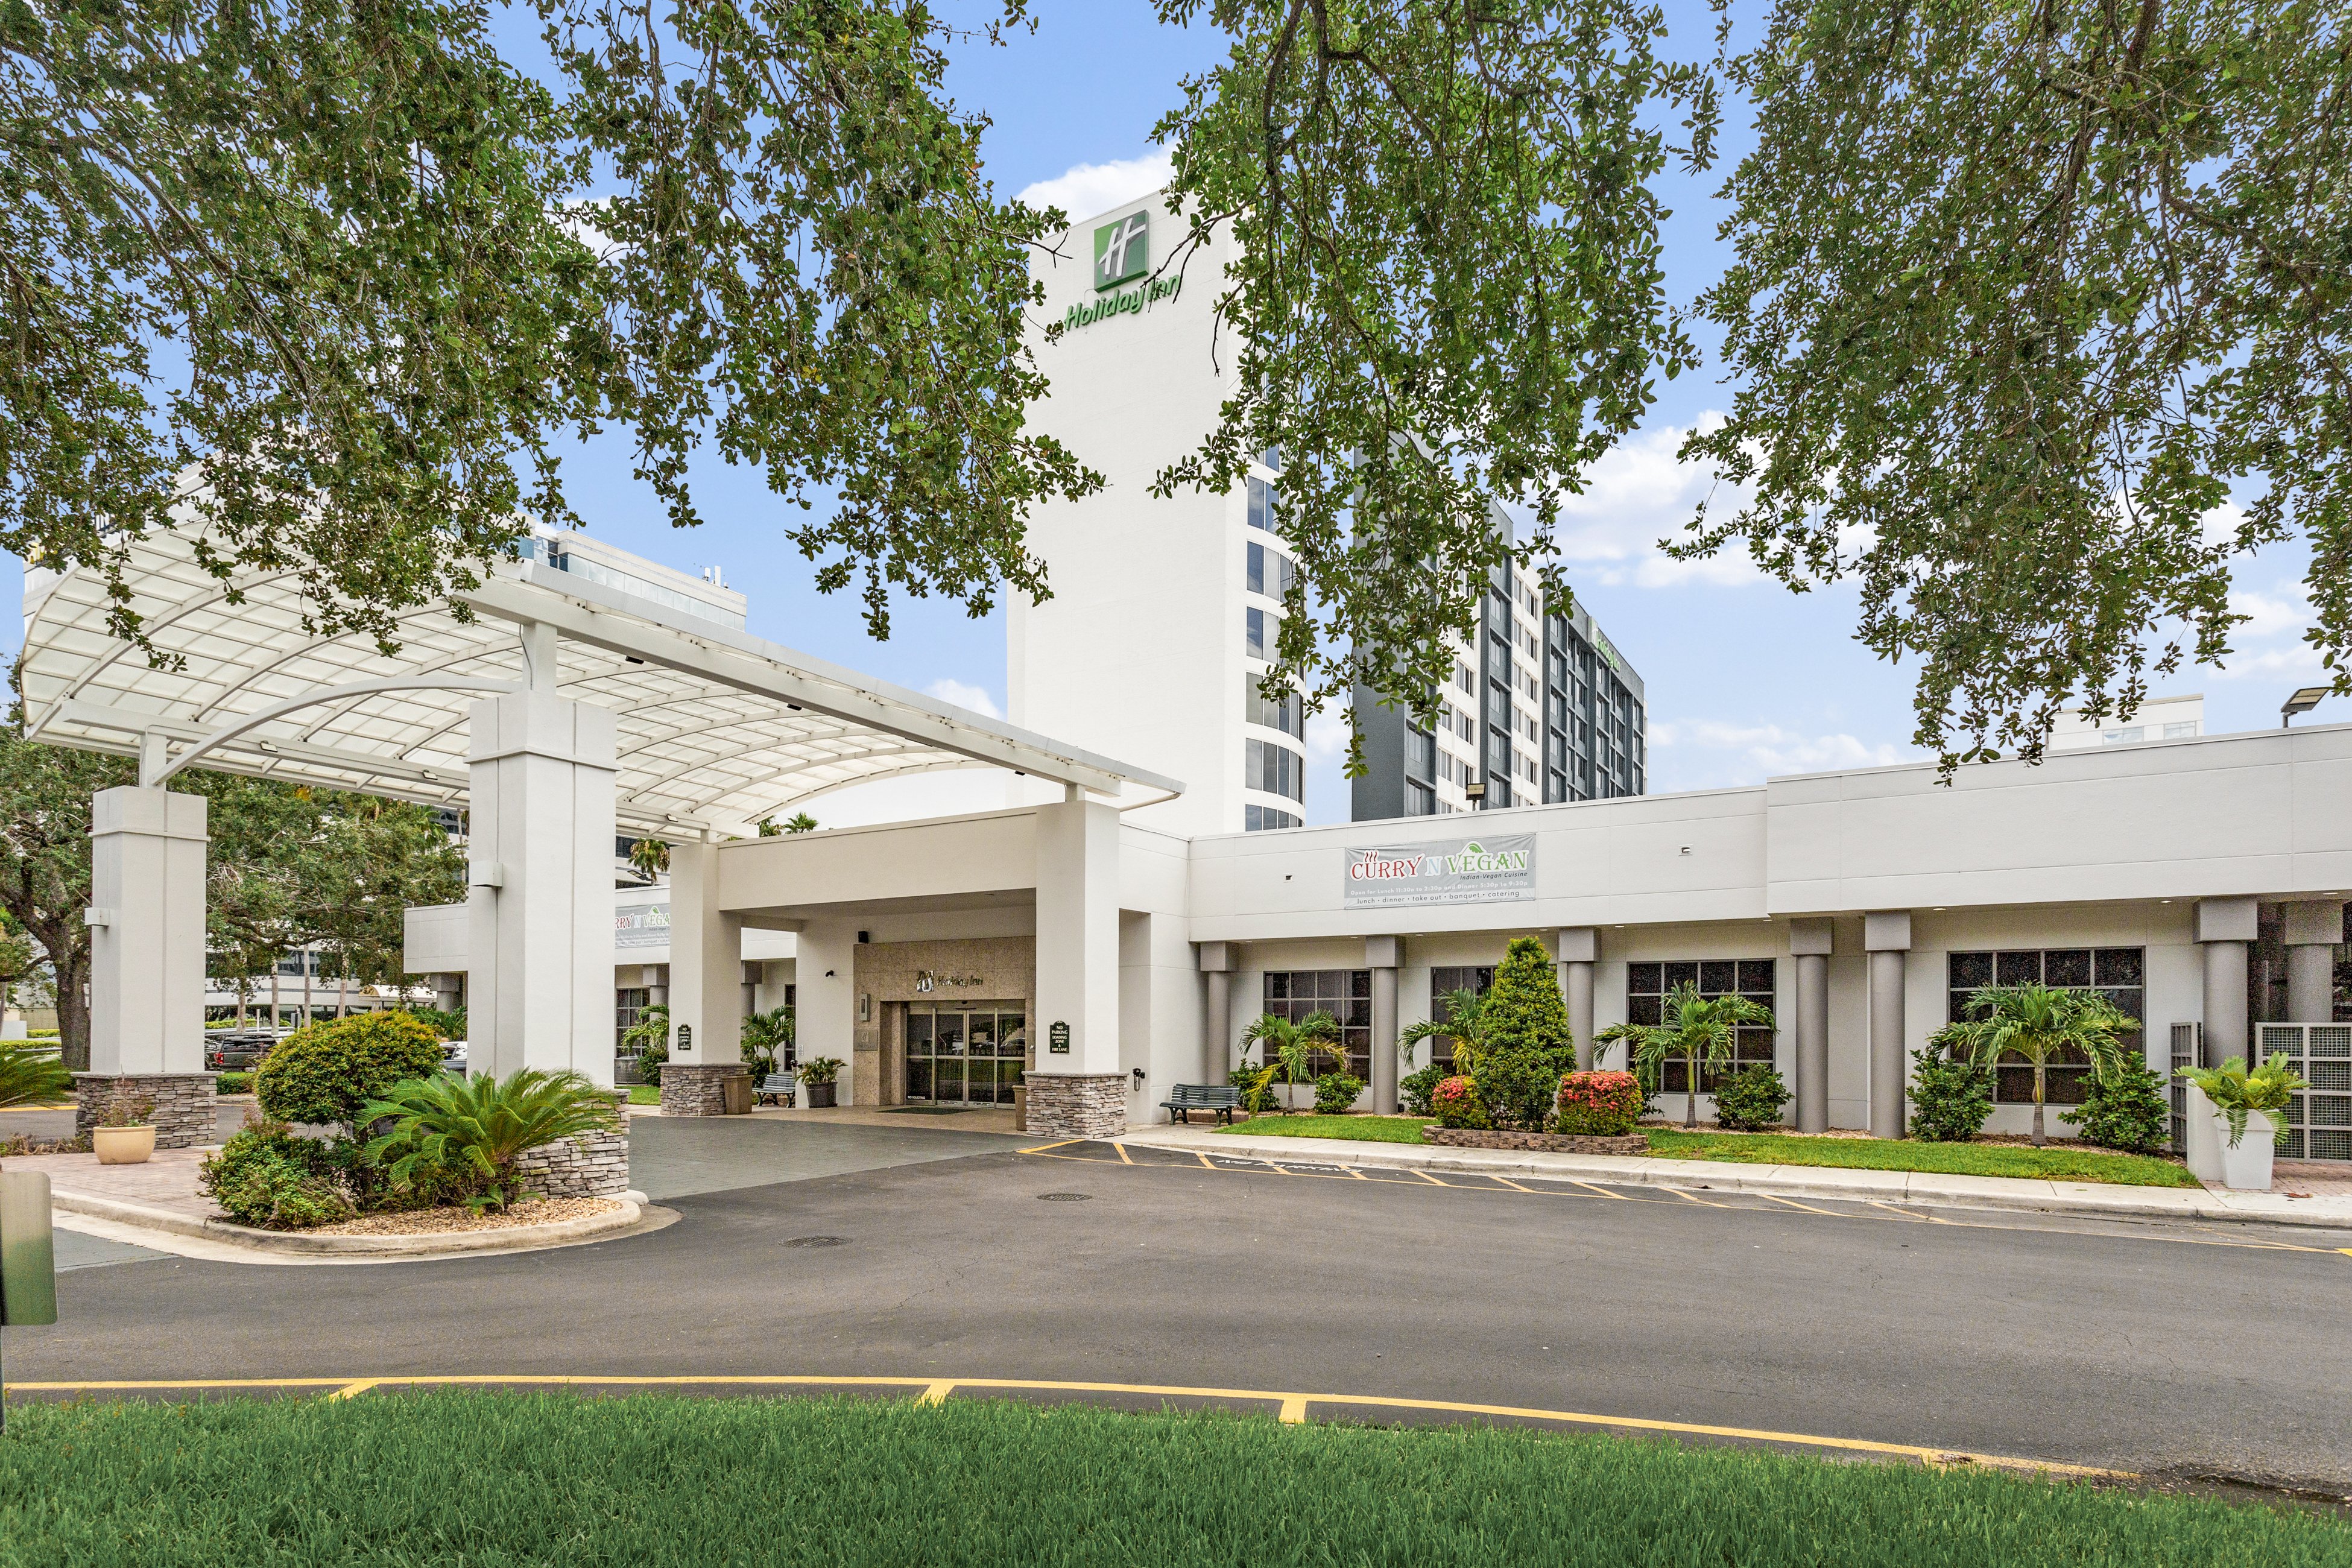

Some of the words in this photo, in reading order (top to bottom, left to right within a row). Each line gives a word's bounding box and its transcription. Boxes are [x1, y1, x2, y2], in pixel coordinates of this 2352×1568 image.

[1064, 287, 1146, 331] Holiday
[1147, 274, 1181, 303] Inn
[1351, 855, 1423, 879] CURRY
[1428, 858, 1441, 874] N
[1447, 850, 1527, 873] VEGAN
[615, 914, 633, 929] RRY
[642, 913, 670, 926] VEGA
[1253, 1162, 1364, 1172] PARKING
